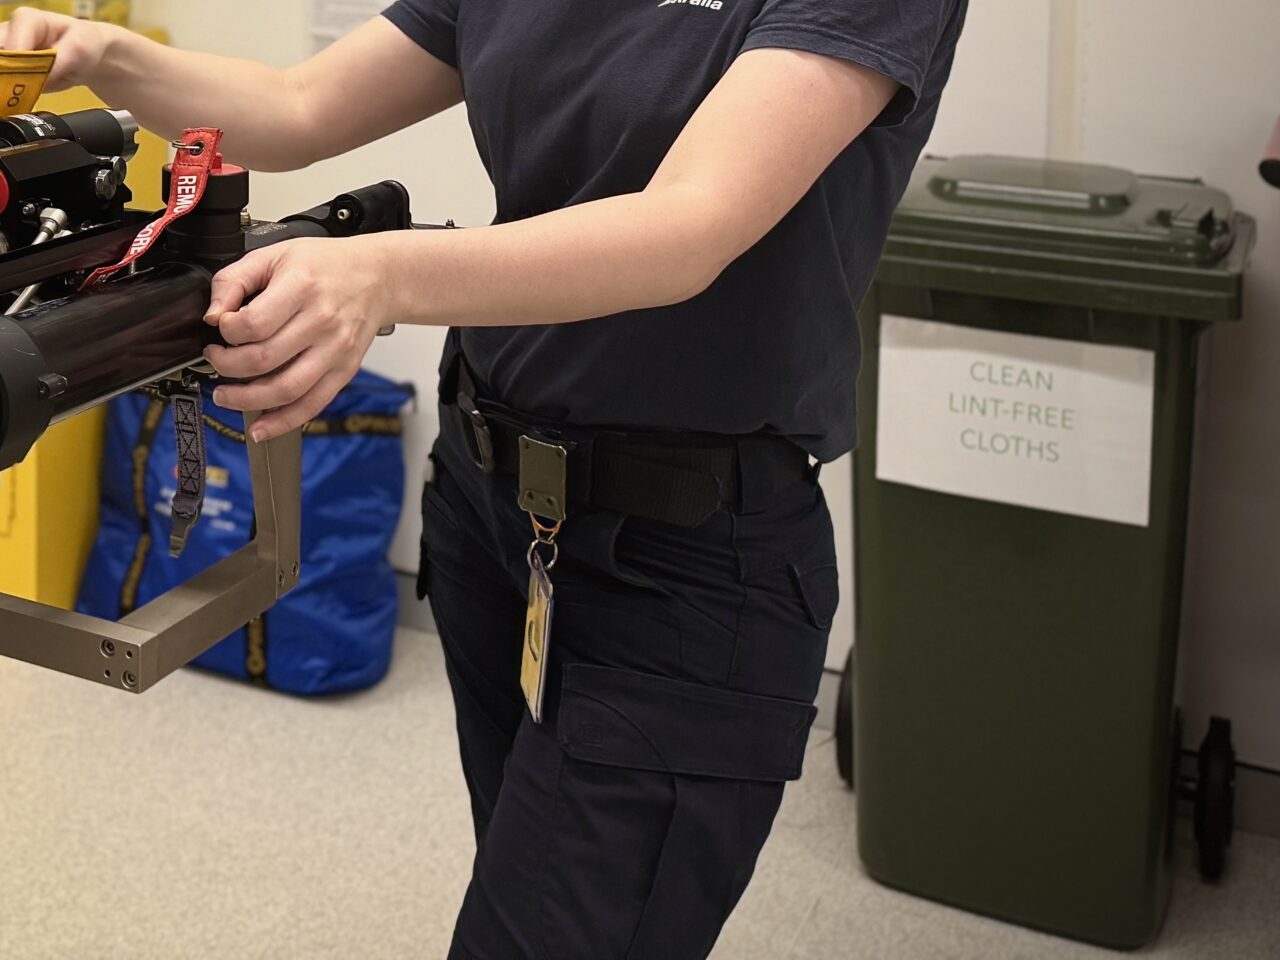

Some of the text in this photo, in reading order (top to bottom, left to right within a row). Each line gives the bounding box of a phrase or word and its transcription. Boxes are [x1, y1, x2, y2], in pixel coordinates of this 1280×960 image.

[969, 361, 1054, 391] CLEAN
[948, 392, 1076, 430] LINT-FREE
[960, 428, 1061, 463] CLOTHS
